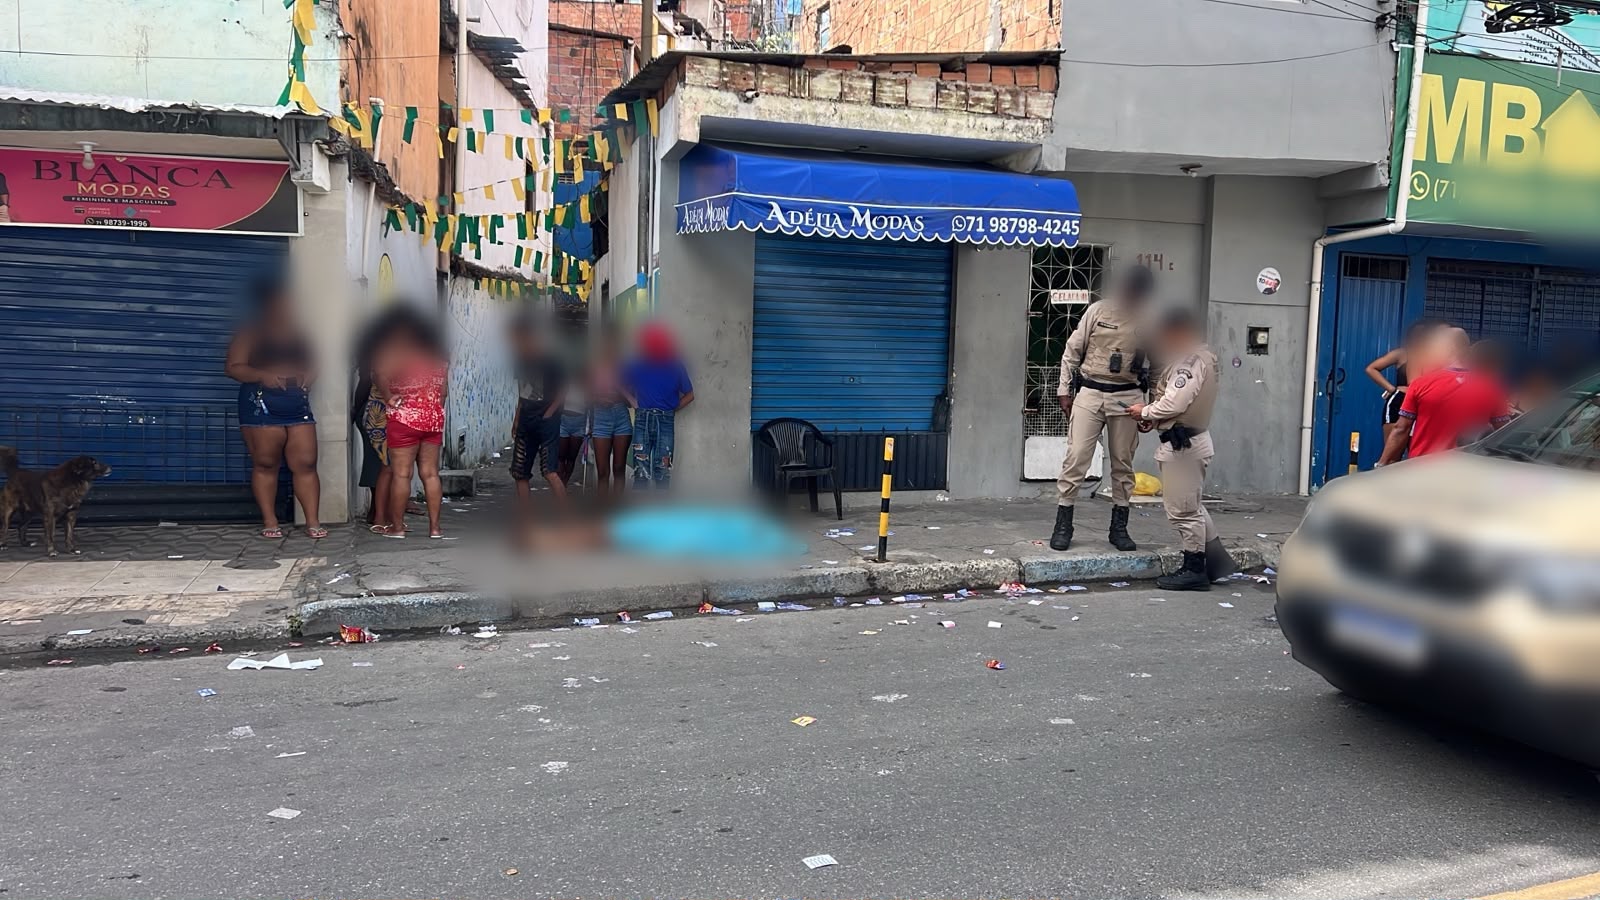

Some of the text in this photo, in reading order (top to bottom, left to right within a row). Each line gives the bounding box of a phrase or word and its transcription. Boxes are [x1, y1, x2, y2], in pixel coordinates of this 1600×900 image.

[32, 159, 234, 189] BIANCA
[77, 182, 171, 199] MODAS
[121, 198, 169, 206] MASCULINA
[103, 218, 148, 227] 98739-1996
[766, 201, 925, 234] ADÉLIA MODAS
[966, 215, 1080, 236] 71 98798-4245
